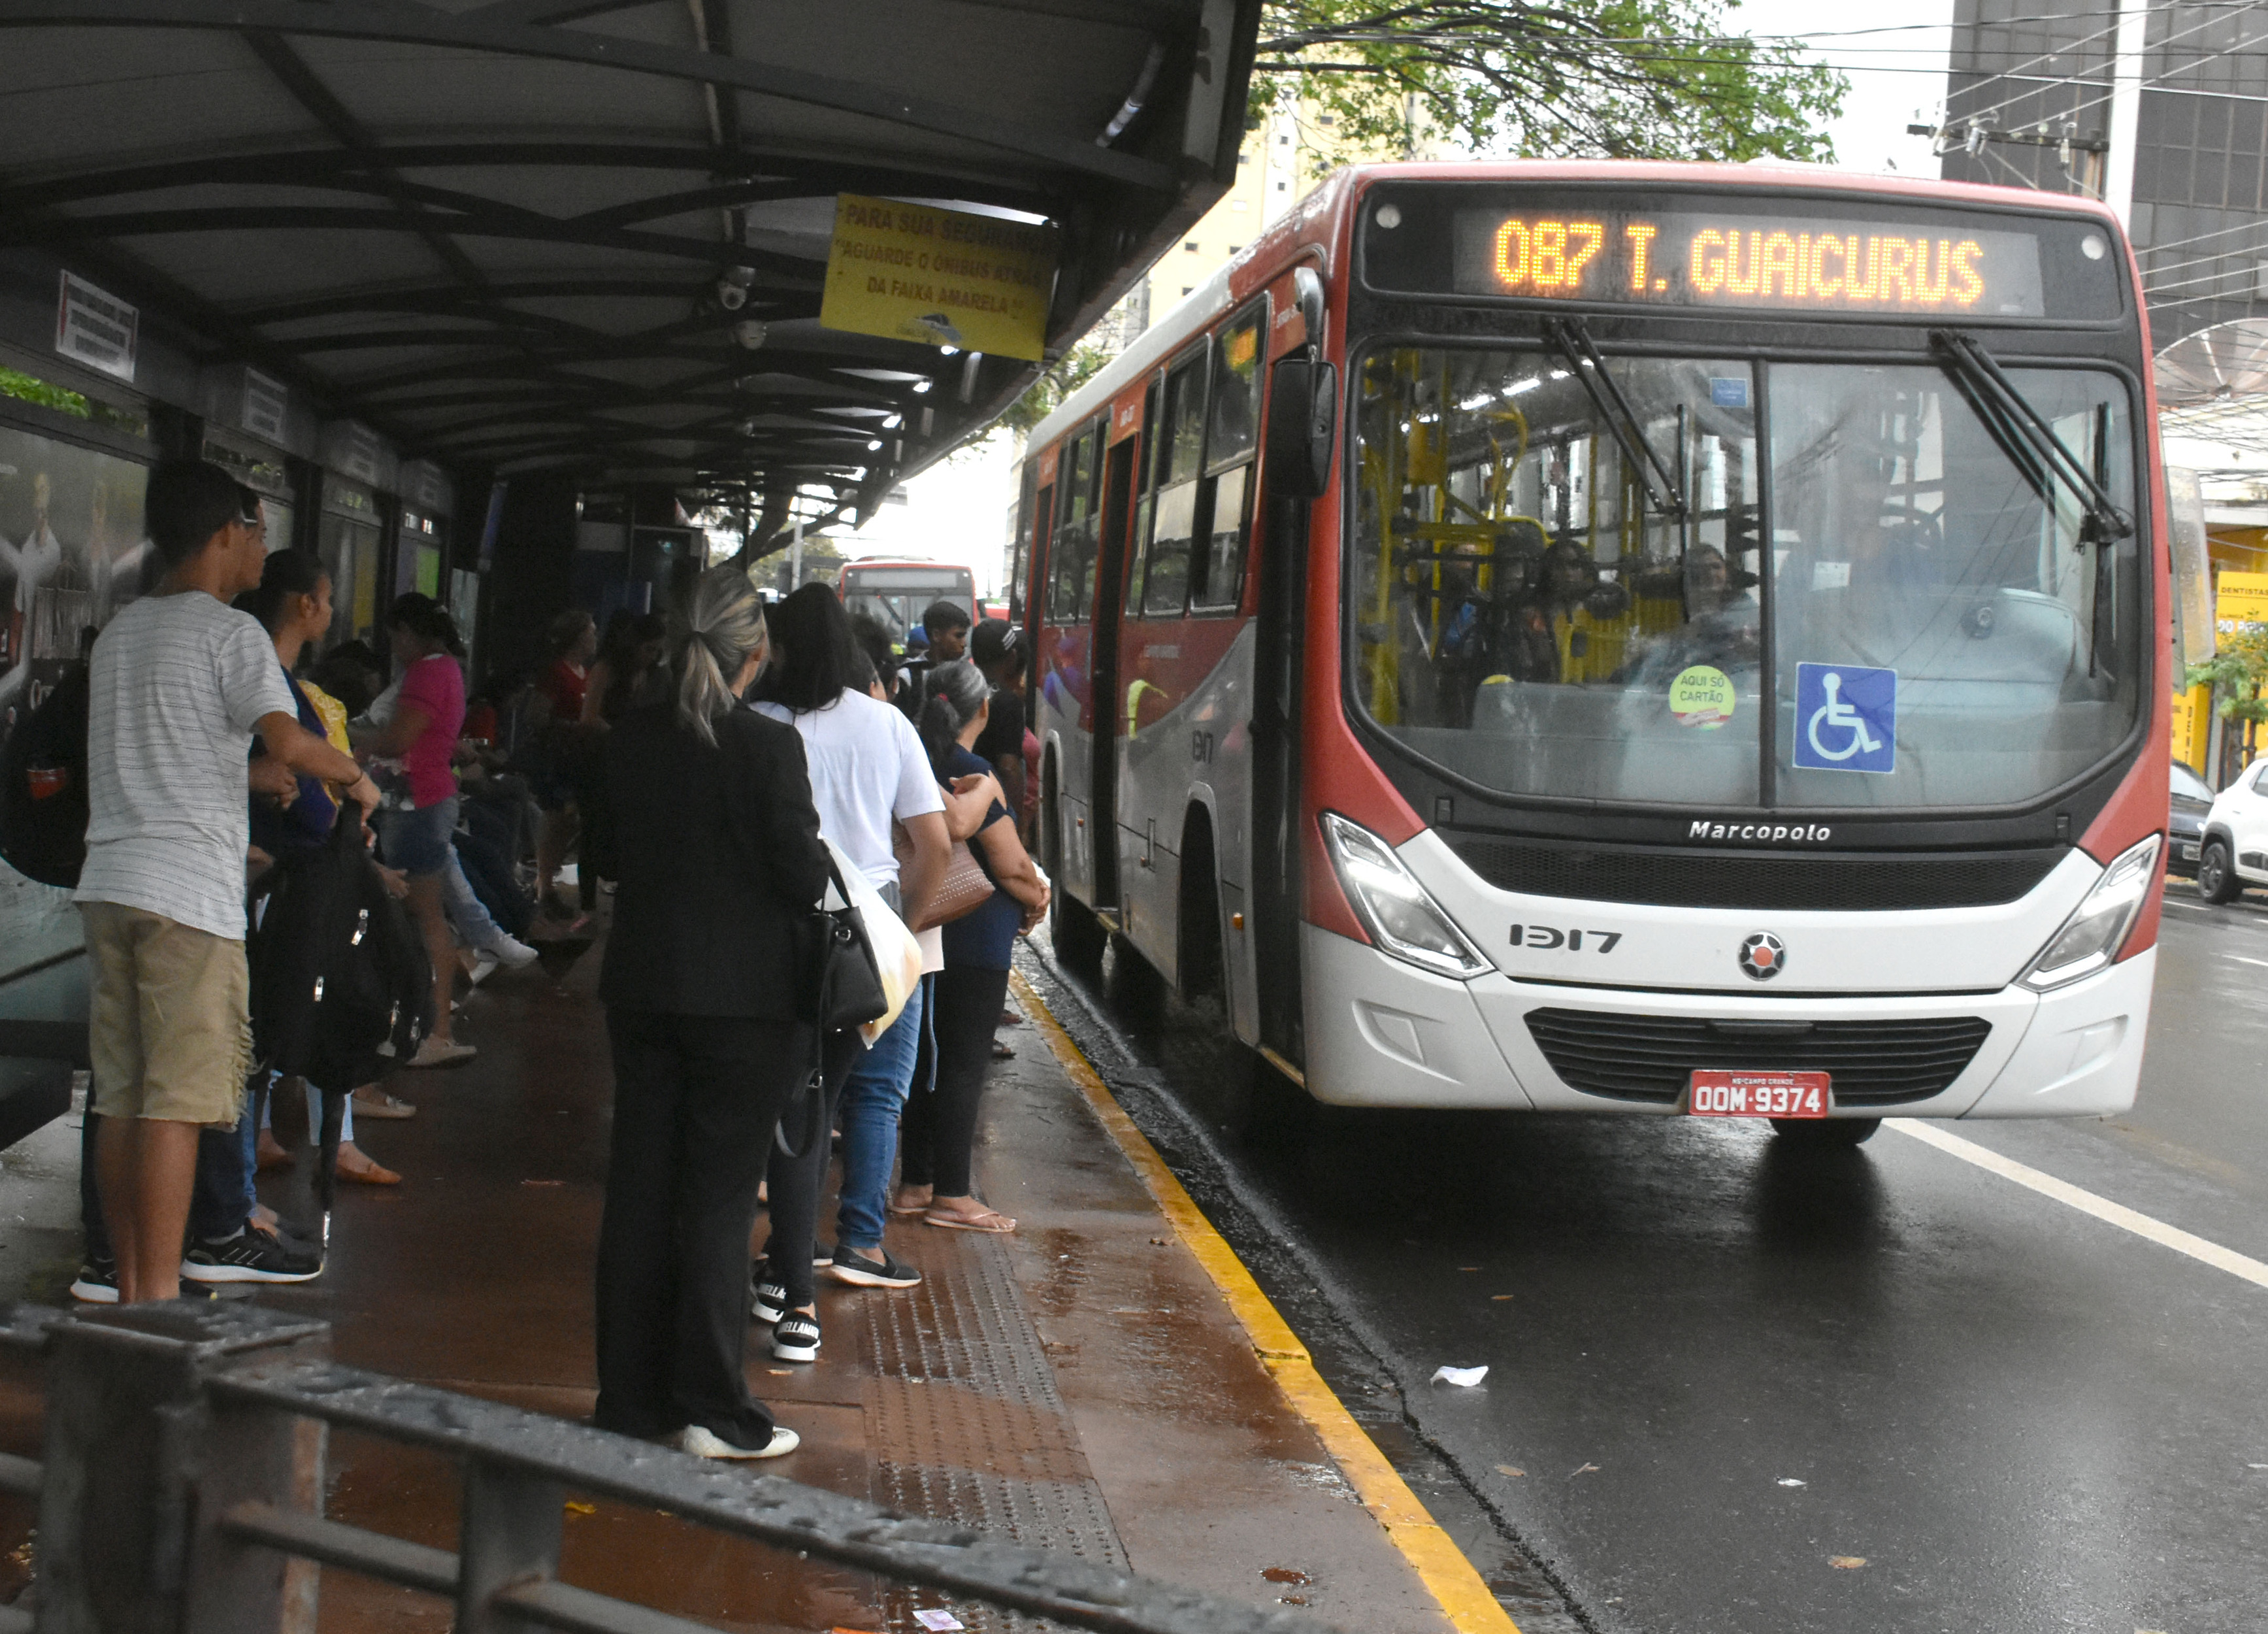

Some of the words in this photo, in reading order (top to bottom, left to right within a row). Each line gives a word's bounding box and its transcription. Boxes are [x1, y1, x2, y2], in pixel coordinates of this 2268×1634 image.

[846, 205, 892, 230] PARA
[899, 212, 934, 238] SUA
[919, 254, 927, 270] O
[1496, 220, 1603, 286] 087
[1627, 225, 1667, 290] T.
[1691, 229, 1984, 303] GUAICURUS
[867, 276, 887, 295] DA
[892, 280, 933, 303] FAIXA
[1681, 675, 1707, 686] AQUI
[1710, 674, 1724, 688] SÓ
[1680, 690, 1724, 703] CARTÃO
[1688, 821, 1831, 842] Marcopolo
[1509, 924, 1622, 954] 1317
